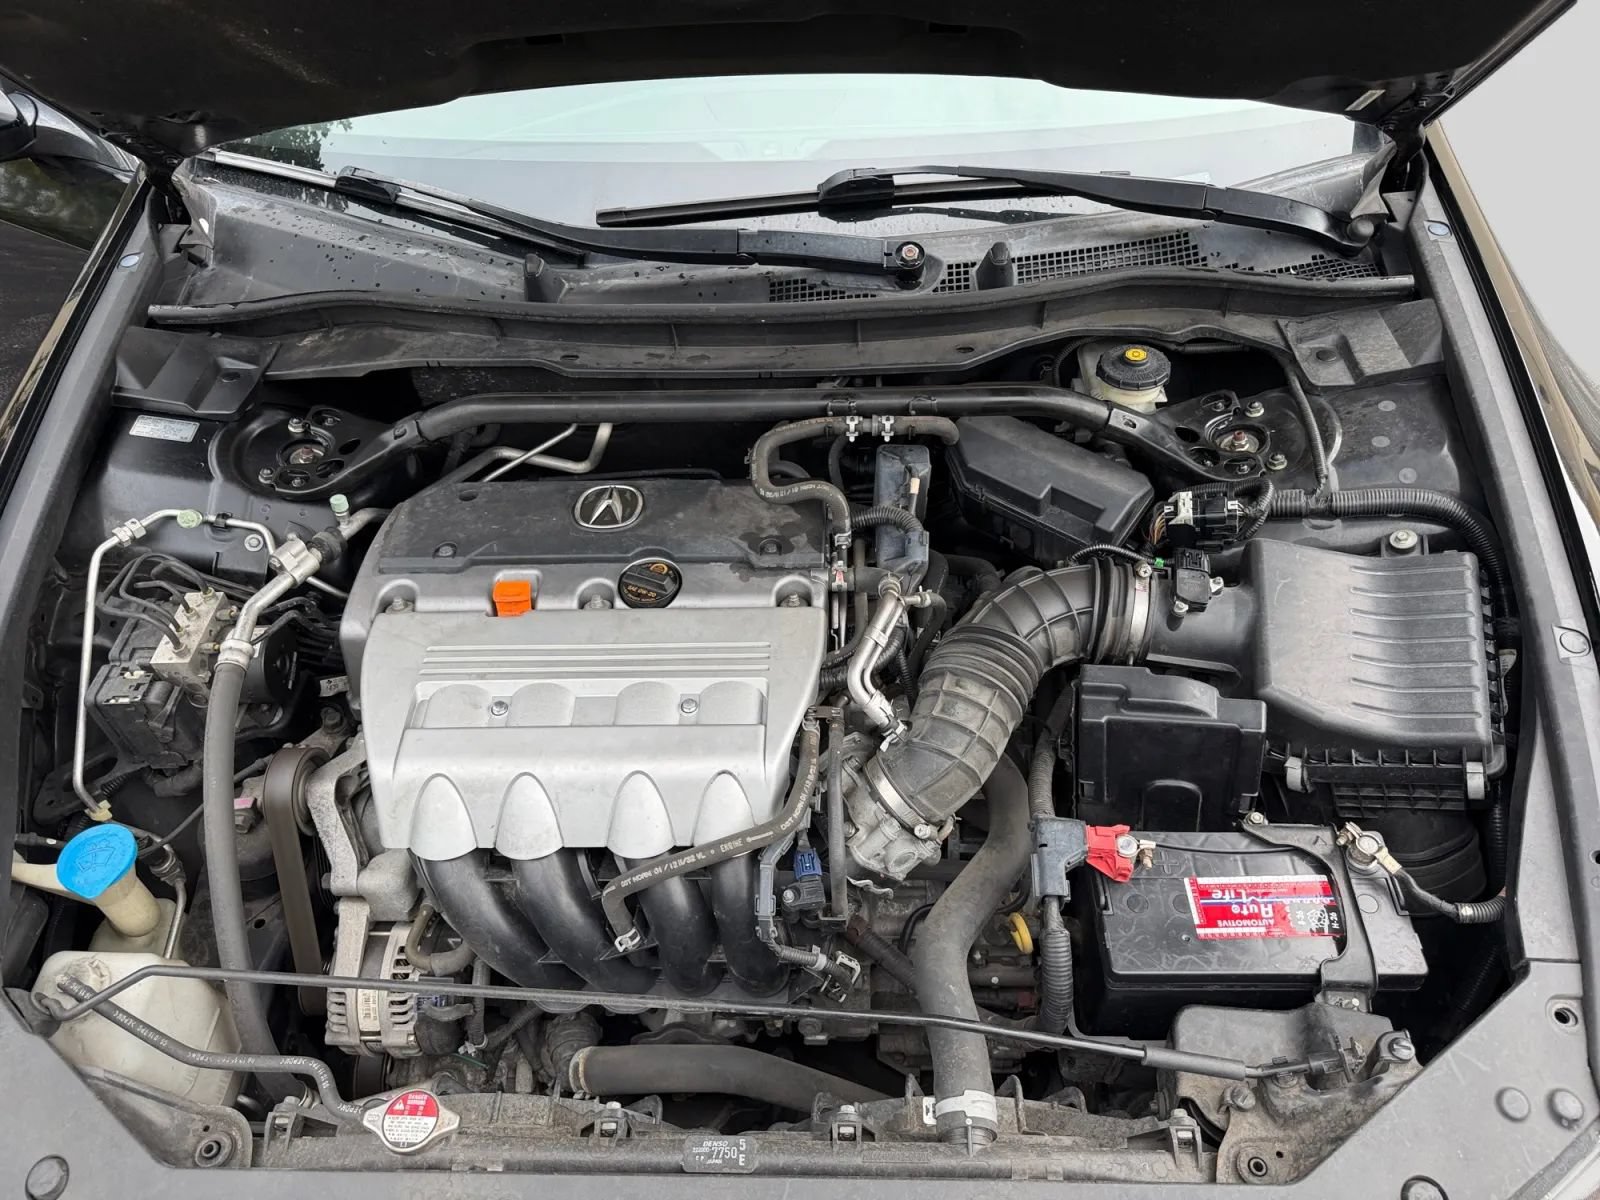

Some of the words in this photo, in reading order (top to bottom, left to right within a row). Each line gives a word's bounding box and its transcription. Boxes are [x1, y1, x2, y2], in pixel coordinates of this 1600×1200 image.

[1211, 889, 1247, 903] Life
[1231, 903, 1274, 920] Auto
[1217, 919, 1275, 927] AUTOMOTIVE
[739, 1139, 746, 1151] 5
[738, 1154, 746, 1166] E
